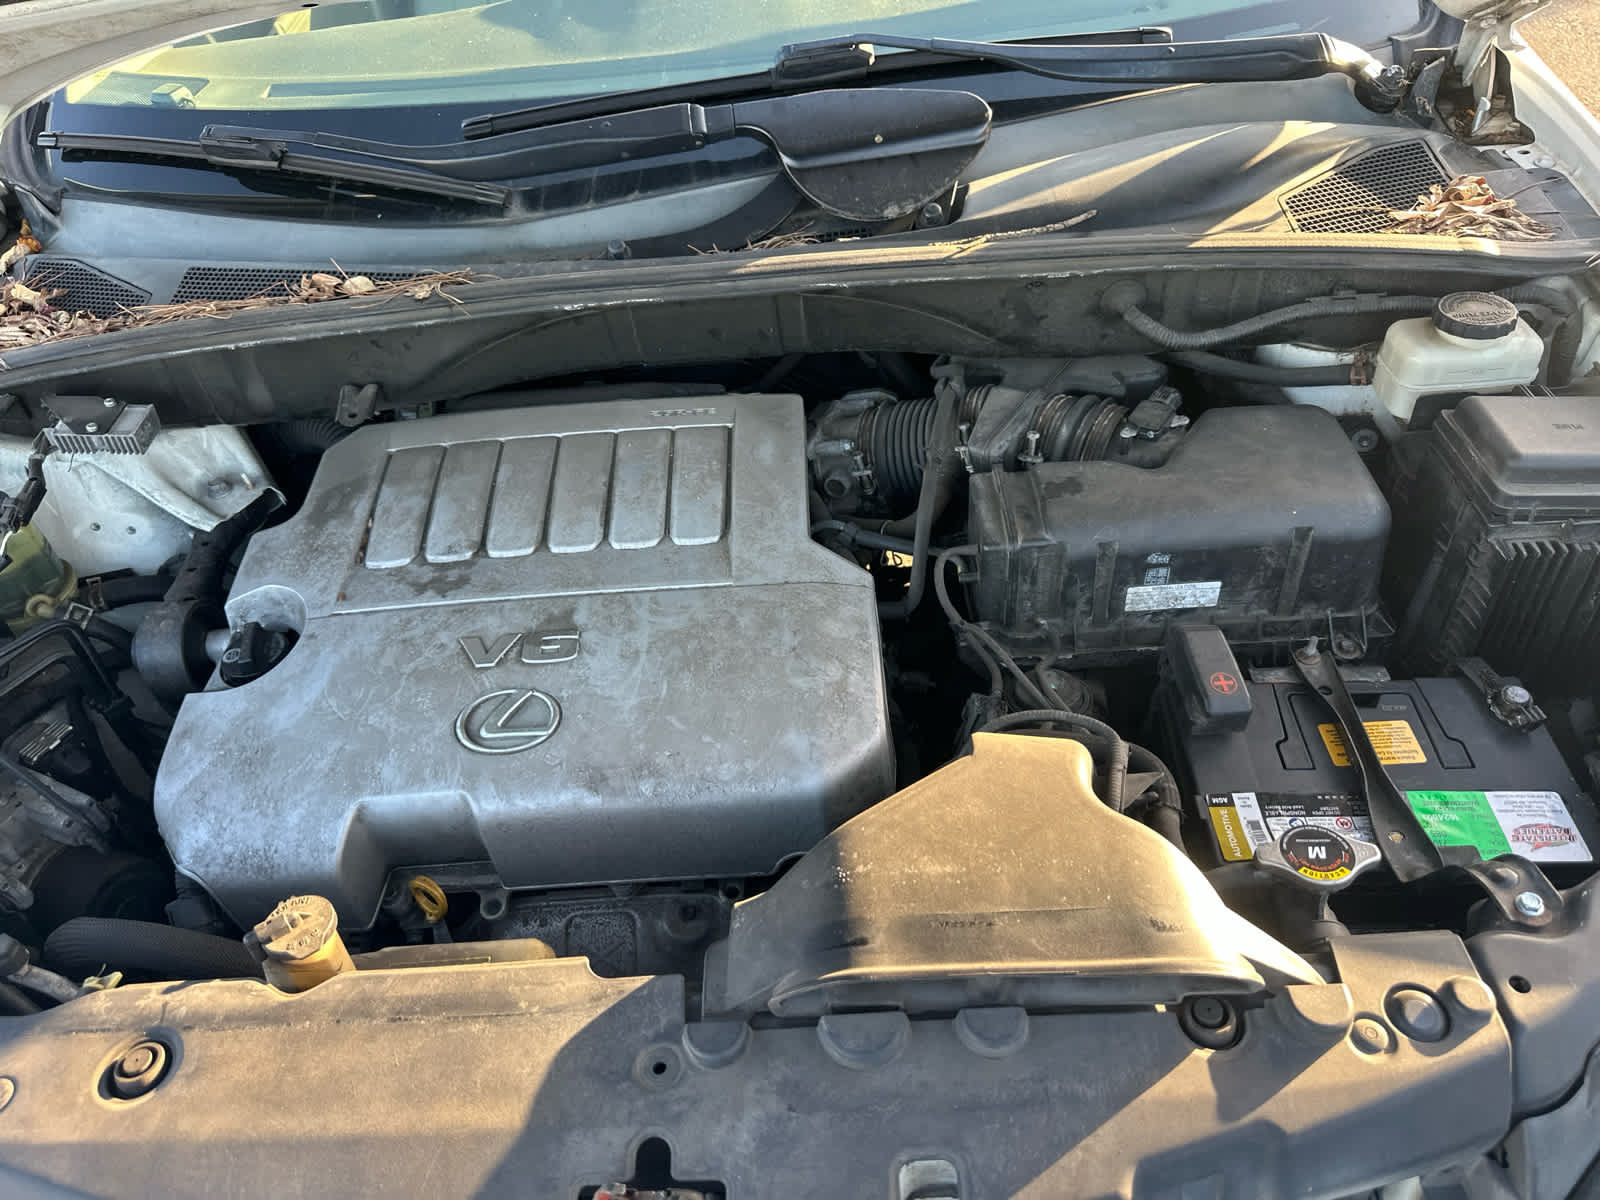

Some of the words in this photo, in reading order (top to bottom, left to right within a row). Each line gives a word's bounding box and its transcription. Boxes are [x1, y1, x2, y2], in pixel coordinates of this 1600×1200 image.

[457, 630, 580, 668] V6
[1219, 809, 1241, 857] AUTOMOTIVE
[1513, 826, 1571, 835] BATTERIES
[1512, 834, 1576, 842] INTERSTATE
[1307, 846, 1327, 859] M
[1303, 868, 1341, 880] CAUTION
